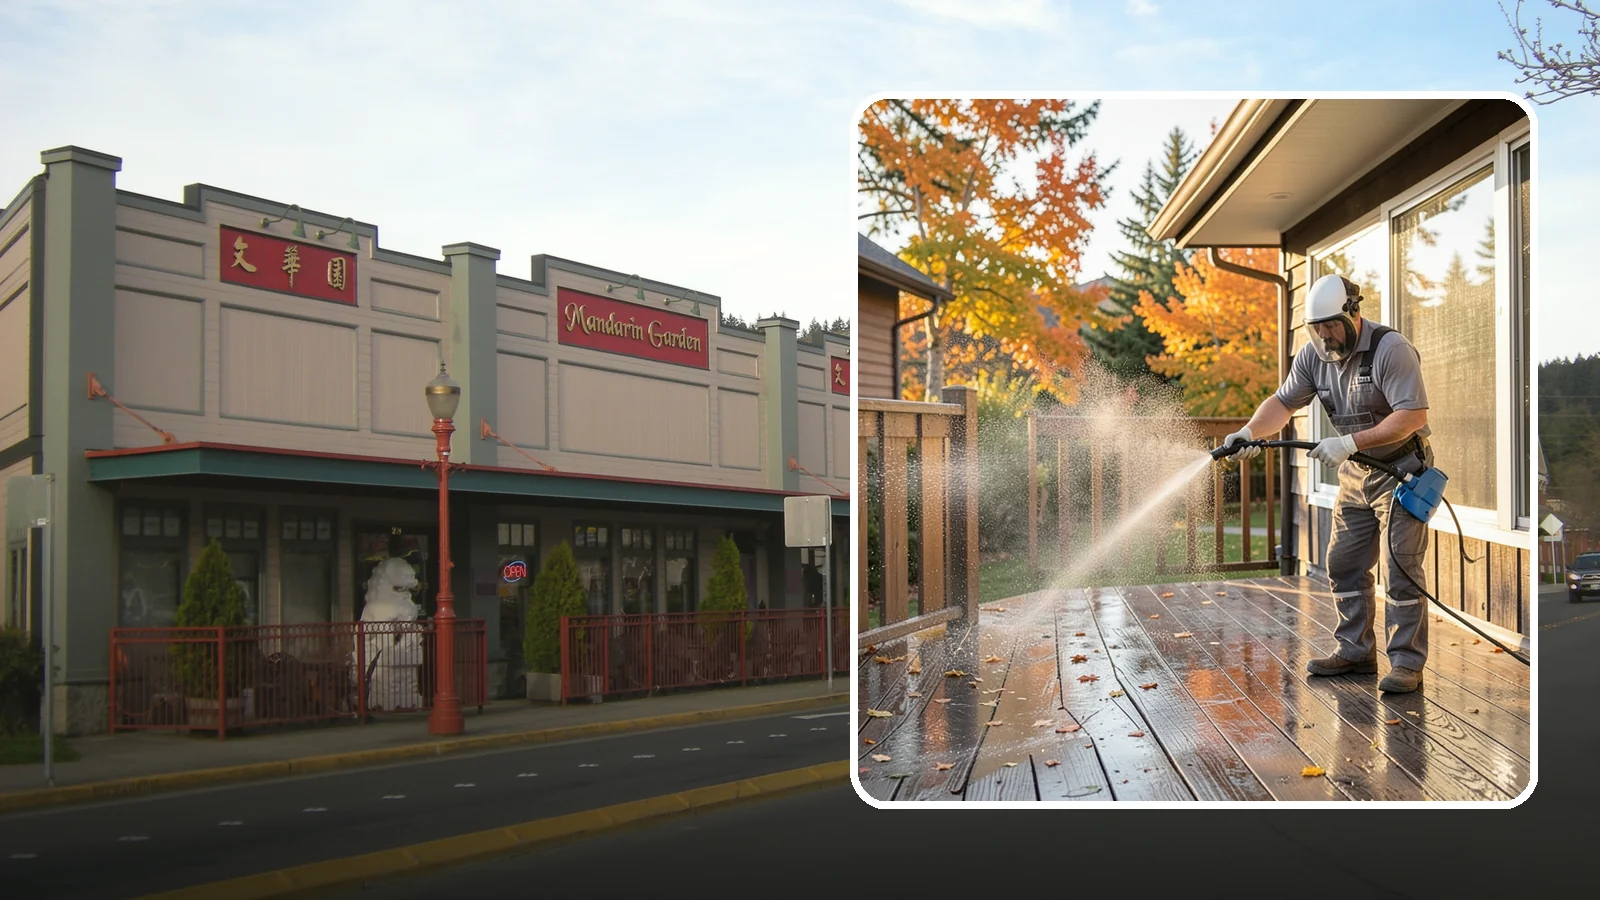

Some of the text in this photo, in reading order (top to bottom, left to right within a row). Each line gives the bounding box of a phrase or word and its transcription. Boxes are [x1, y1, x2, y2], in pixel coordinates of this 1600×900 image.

[231, 236, 346, 290] 文華園
[564, 302, 702, 352] Mandarin Garden
[503, 565, 527, 579] OPEN
